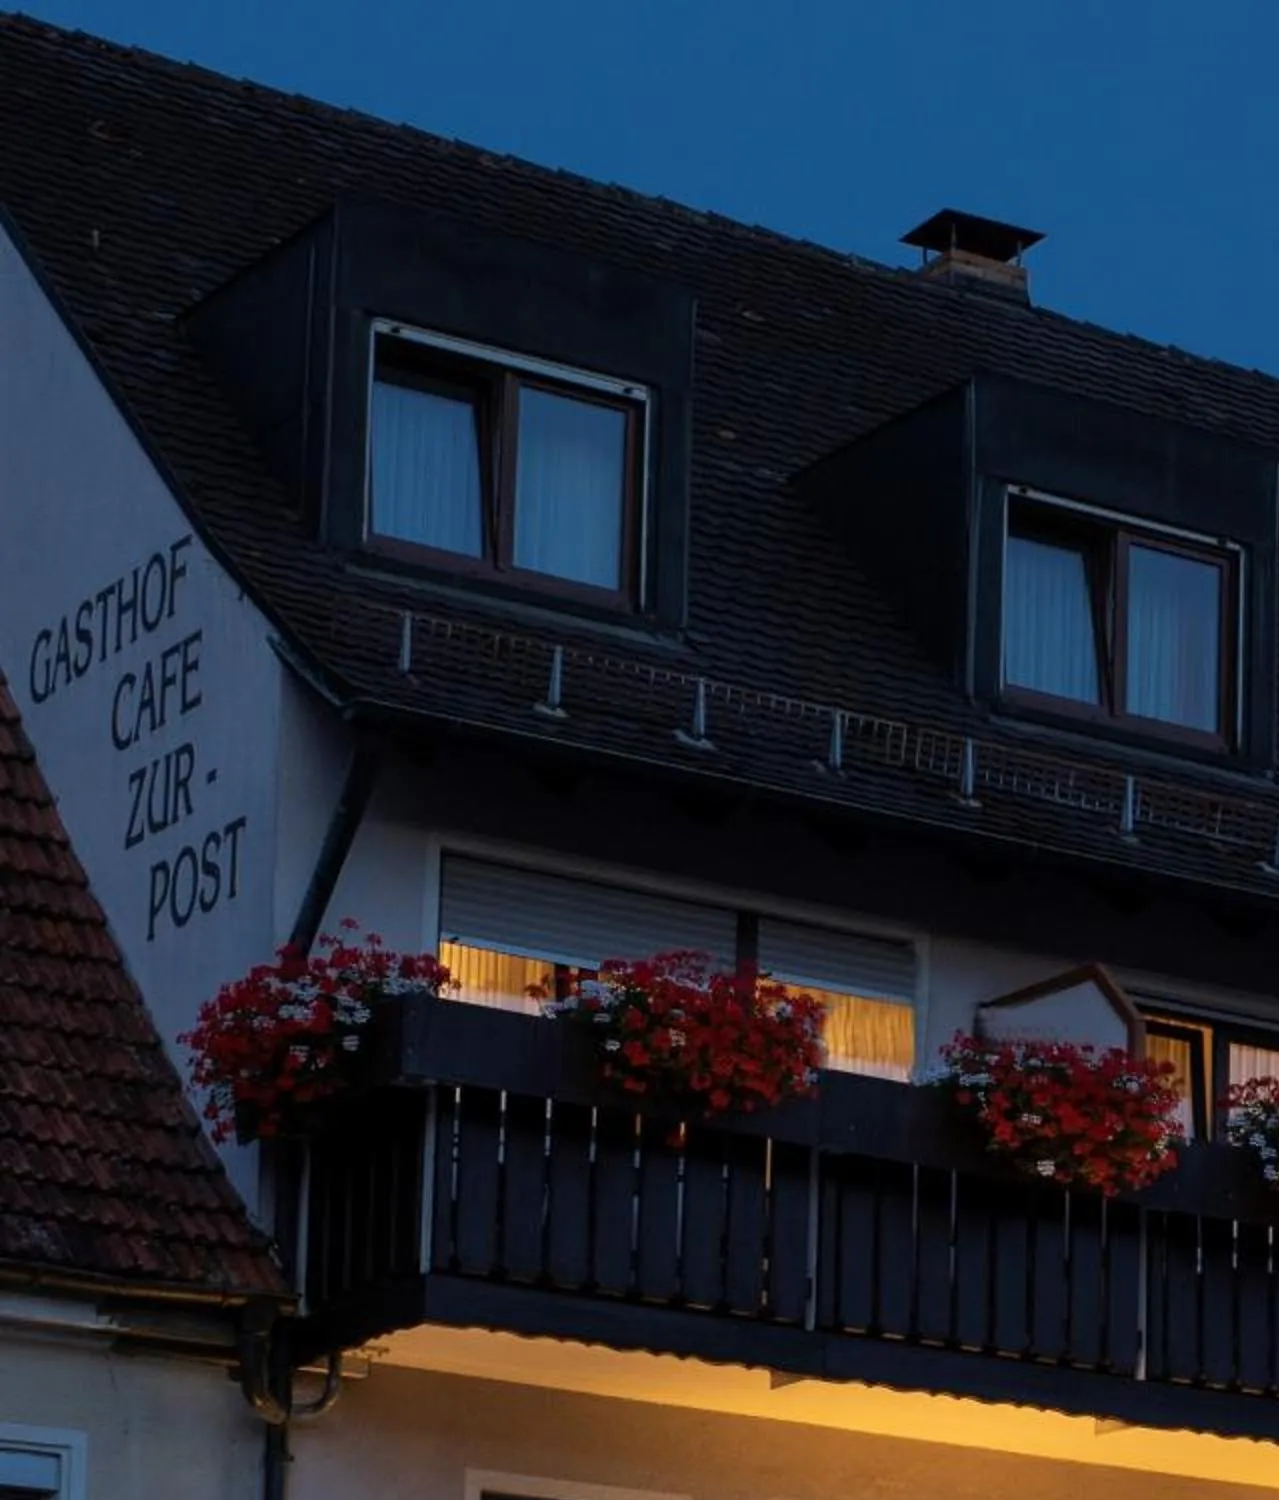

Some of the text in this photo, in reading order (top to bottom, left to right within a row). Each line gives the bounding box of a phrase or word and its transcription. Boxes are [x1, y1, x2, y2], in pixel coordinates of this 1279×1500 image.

[30, 534, 193, 704] GASTHOF
[111, 630, 203, 751] CAFE
[146, 816, 246, 941] POST
